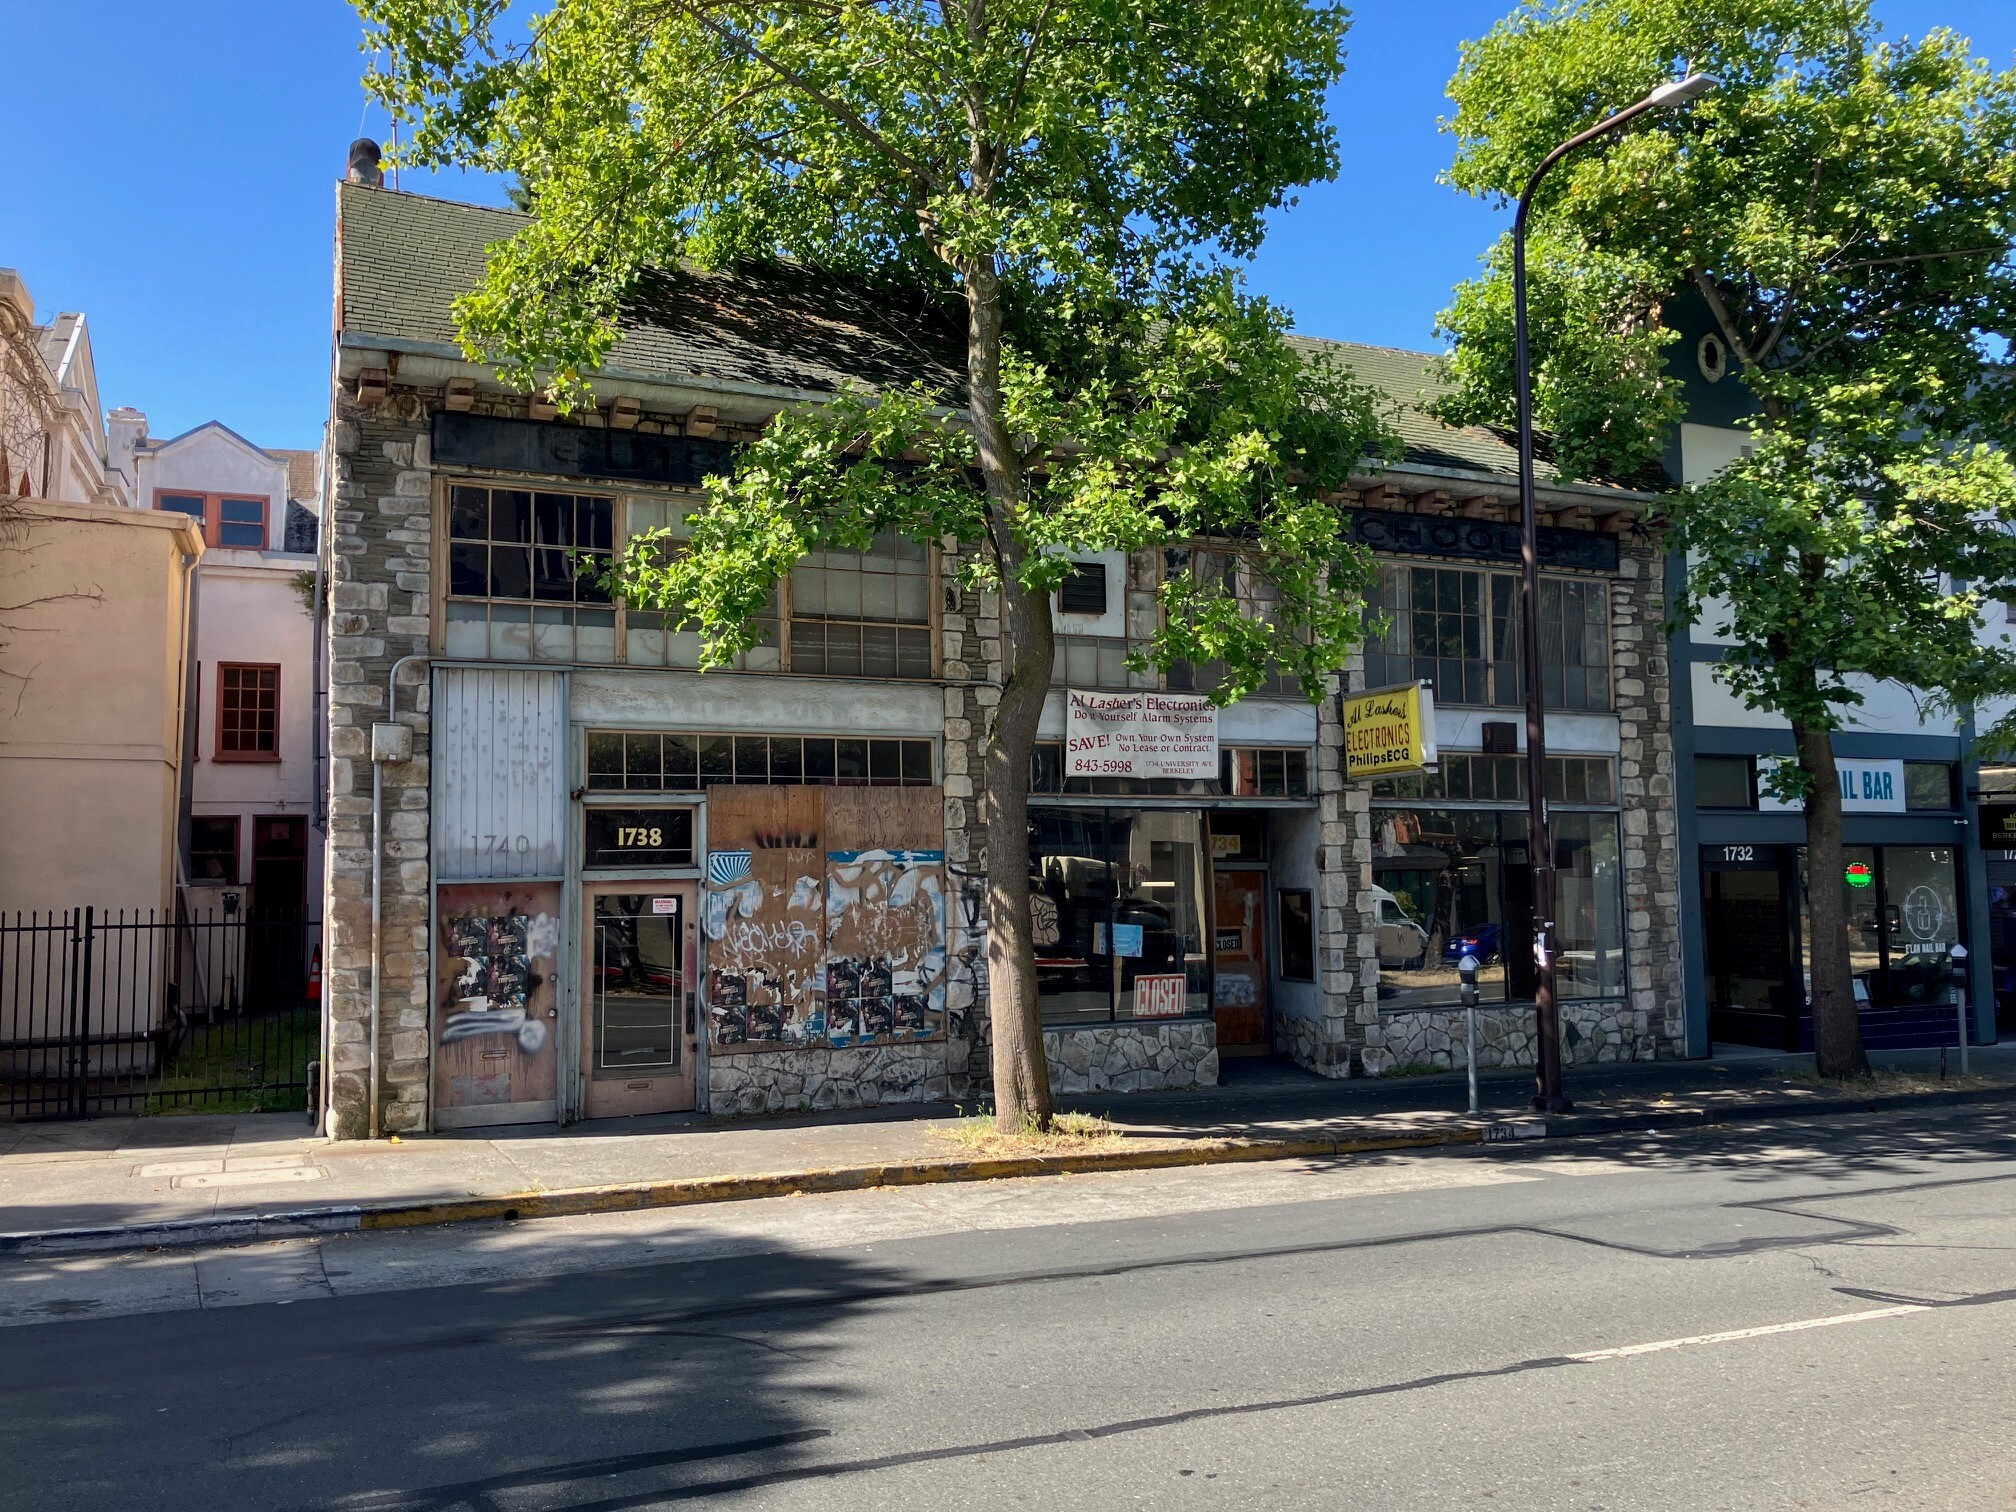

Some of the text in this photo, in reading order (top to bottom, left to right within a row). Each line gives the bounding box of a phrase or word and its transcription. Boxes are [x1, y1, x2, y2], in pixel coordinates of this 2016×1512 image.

[1069, 694, 1216, 712] Al Lasher's Electronics
[1074, 710, 1213, 726] Do it Yourself Alarm Systems
[1069, 733, 1215, 752] SAVE! Own Your Own System
[1346, 722, 1410, 752] ELECTRONICS
[1118, 743, 1131, 752] No
[1133, 743, 1159, 753] Lease
[1160, 745, 1171, 753] or
[1074, 758, 1133, 773] 843-5998
[1160, 760, 1200, 768] UNIVERSITY
[1162, 767, 1195, 775] BERKELEY
[1862, 771, 1894, 800] BAR
[471, 834, 530, 856] 1740
[618, 827, 663, 847] 1738
[1212, 836, 1240, 852] 734
[1723, 846, 1754, 861] 1732
[1136, 978, 1183, 1016] CLOSED
